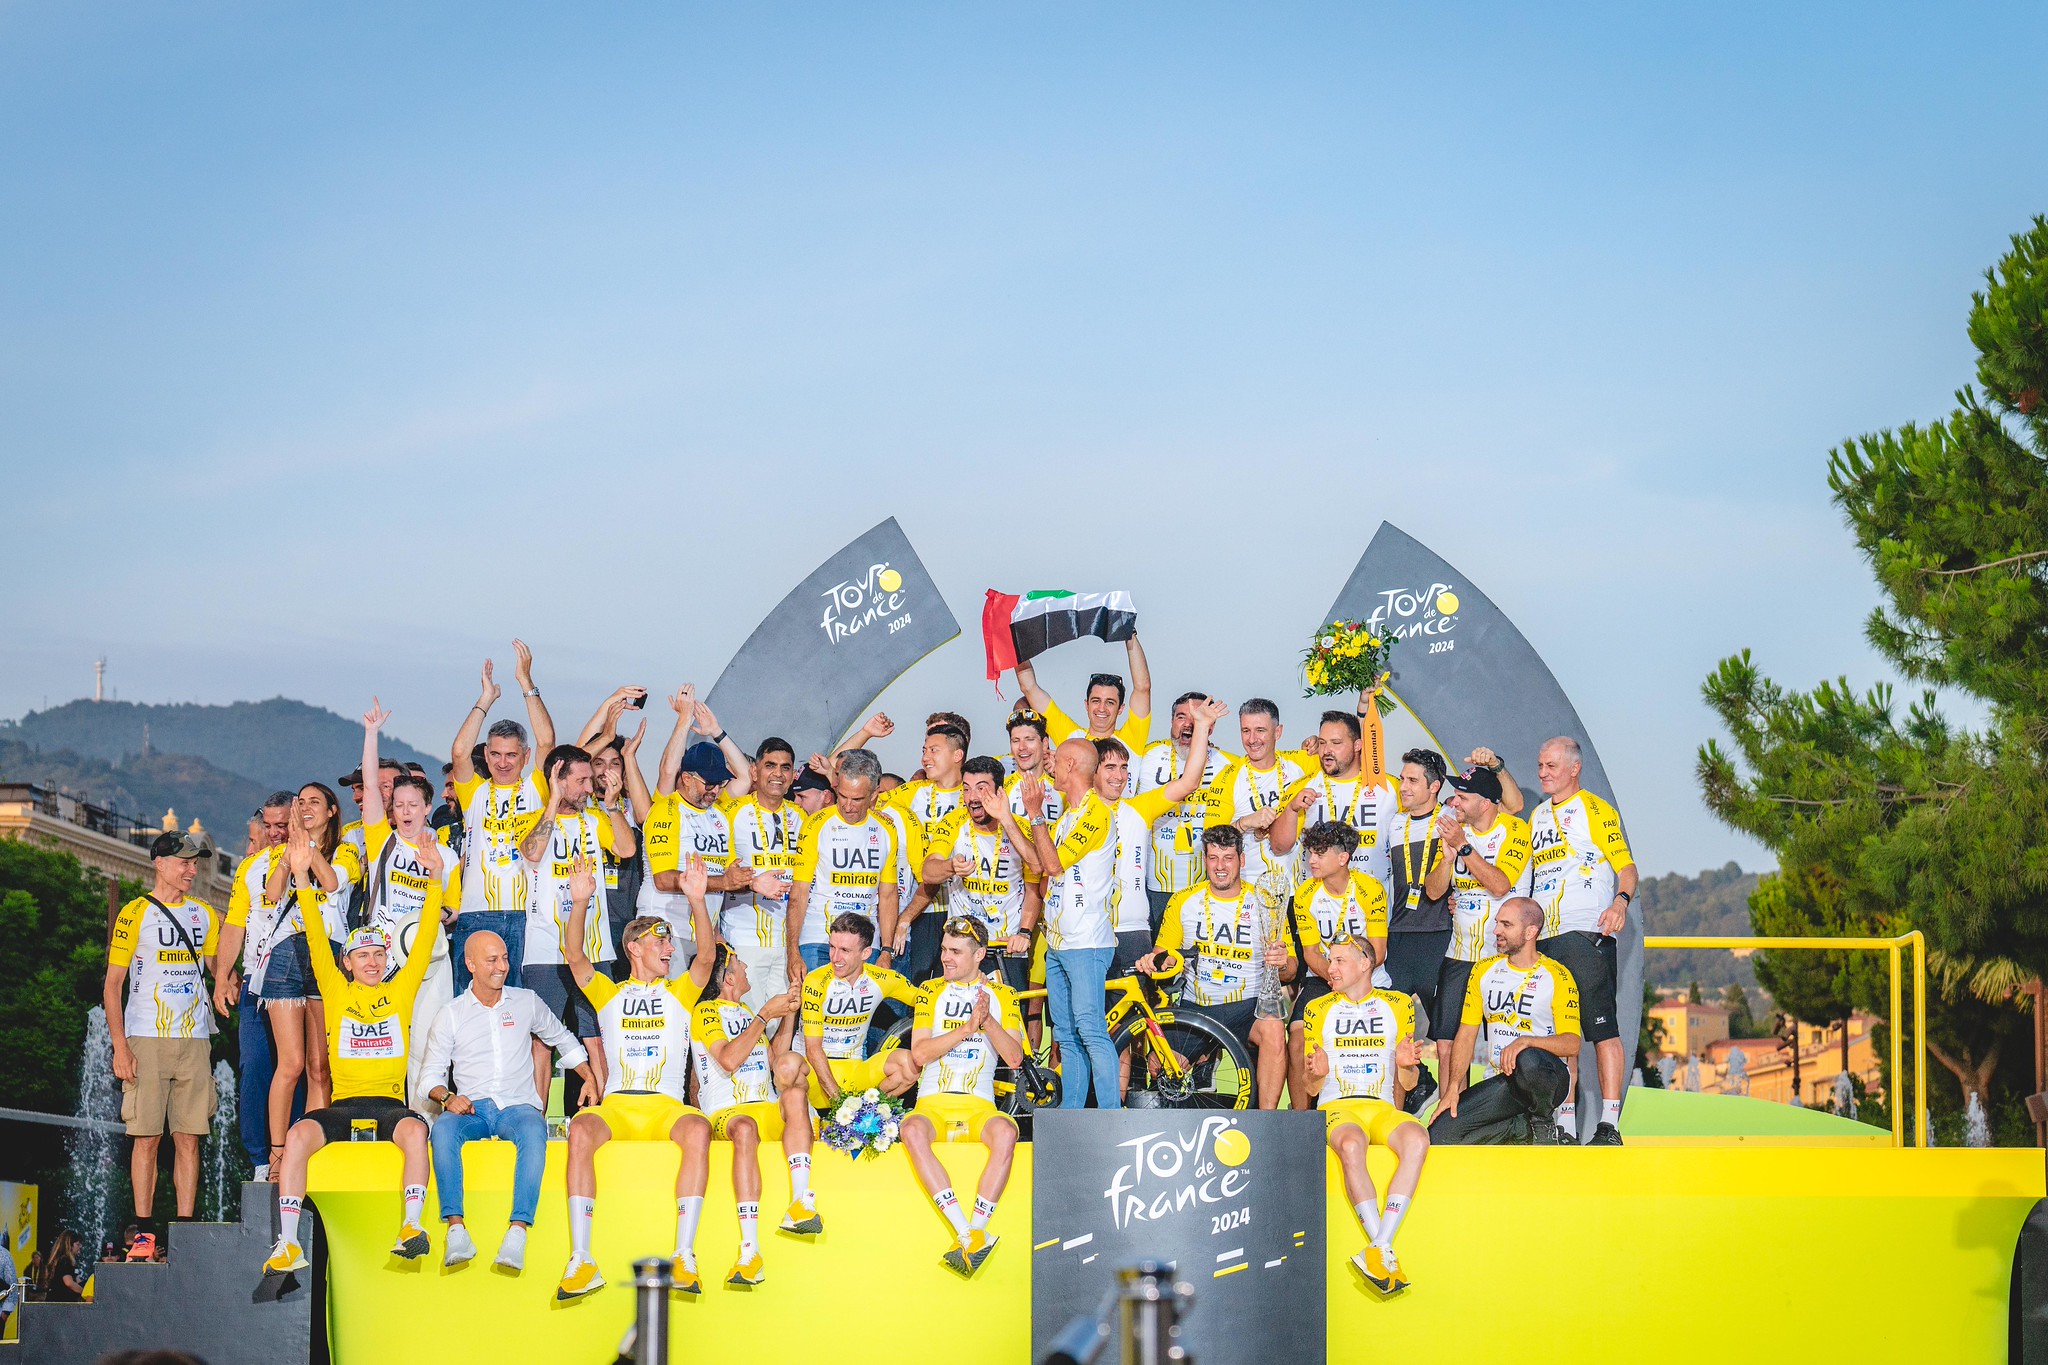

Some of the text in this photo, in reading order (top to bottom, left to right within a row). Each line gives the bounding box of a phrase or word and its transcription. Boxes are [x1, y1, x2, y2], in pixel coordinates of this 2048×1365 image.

[873, 591, 884, 604] de
[1424, 606, 1436, 618] de
[888, 613, 911, 634] 2024
[1429, 640, 1454, 654] 2024
[1155, 766, 1213, 785] UE
[1012, 803, 1058, 820] UE
[694, 833, 729, 852] UAE
[832, 848, 880, 869] UAE
[1506, 849, 1524, 861] ADQ
[978, 858, 1010, 878] AE
[391, 871, 429, 889] Emirate
[832, 872, 878, 885] Emirates
[1075, 894, 1083, 908] IHC
[1196, 922, 1251, 944] UAE
[1319, 919, 1361, 939] UE
[622, 999, 663, 1015] UAE
[827, 996, 873, 1015] UAE
[944, 1001, 973, 1017] UA
[1488, 990, 1535, 1015] UAE
[351, 1021, 390, 1037] UAE
[621, 1018, 665, 1029] Emirates
[824, 1015, 868, 1026] Emirates
[1335, 1017, 1384, 1035] UAE
[351, 1038, 393, 1047] Emirates
[1335, 1037, 1385, 1047] Emirates
[1195, 1157, 1215, 1178] de
[1212, 1207, 1250, 1234] 2024
